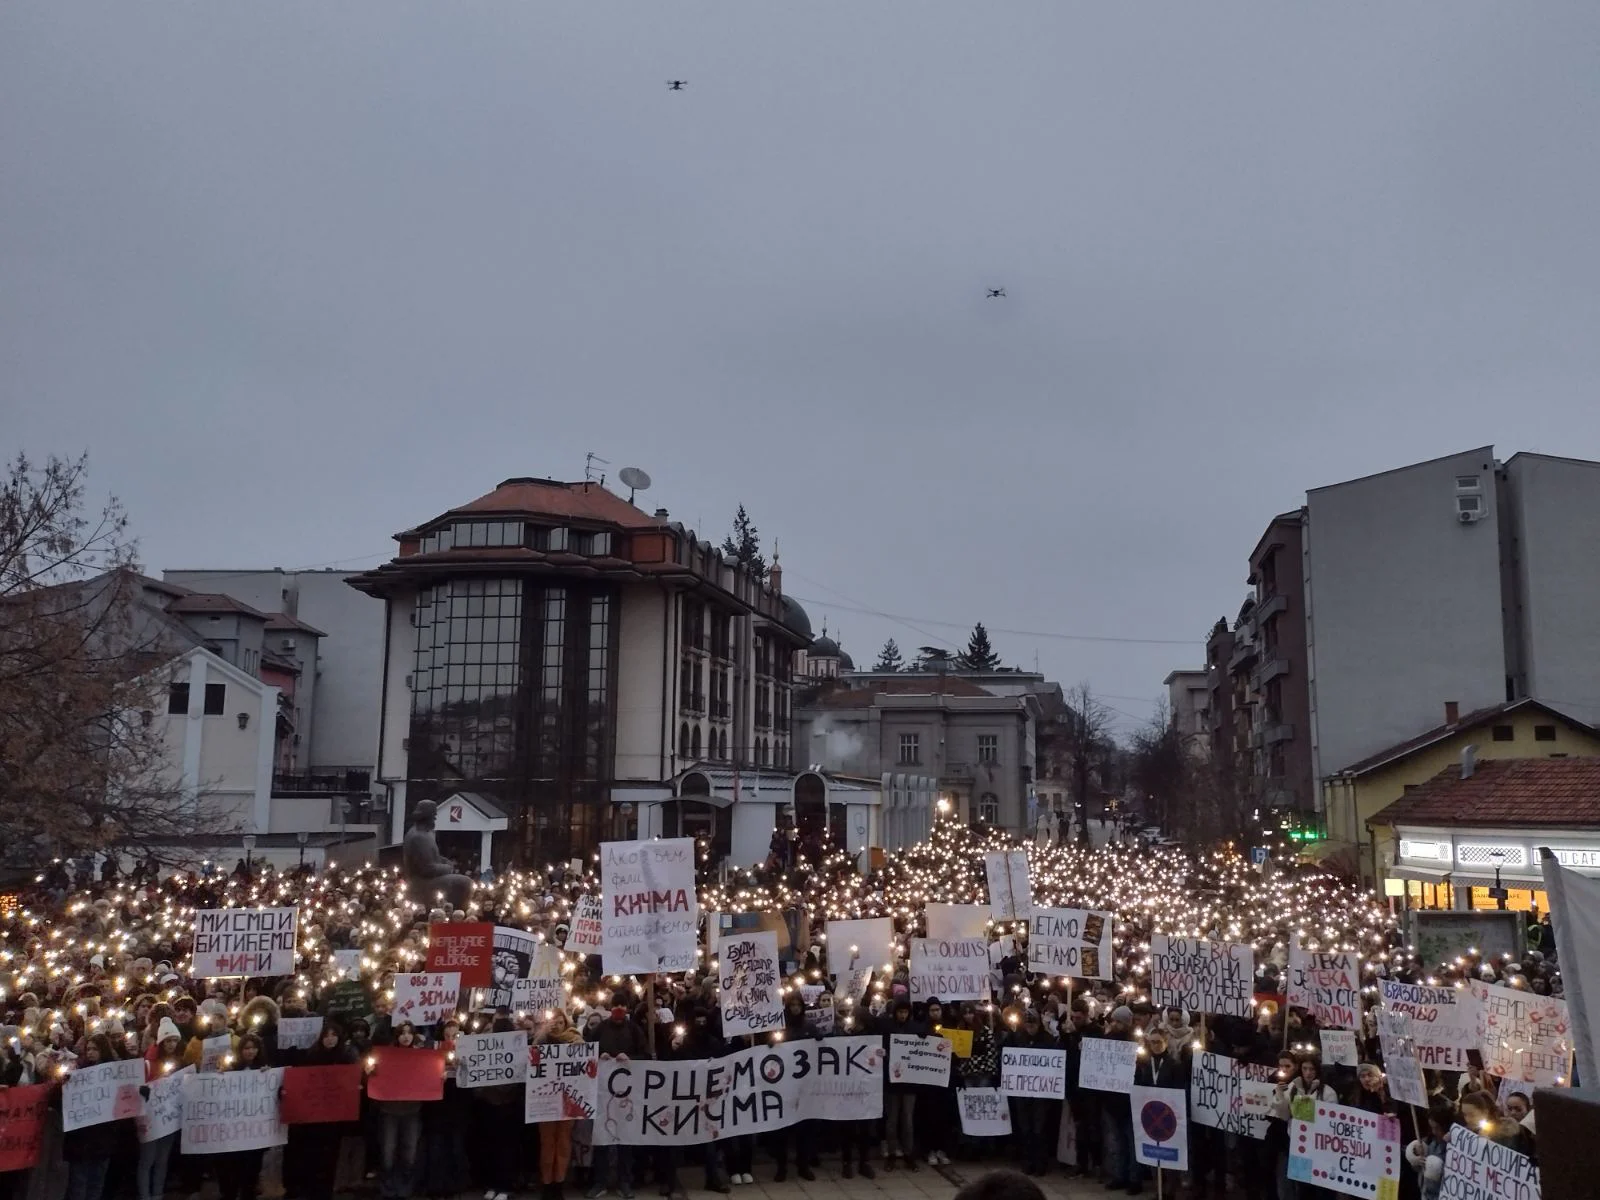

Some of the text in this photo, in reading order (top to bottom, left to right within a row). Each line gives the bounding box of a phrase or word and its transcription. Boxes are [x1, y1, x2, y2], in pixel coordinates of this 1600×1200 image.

[614, 889, 689, 917] КИЧМА
[200, 912, 293, 932] МИ СМО И
[447, 945, 467, 956] BEZ
[727, 941, 756, 962] БУДИ
[1167, 937, 1240, 961] КО ЈЕ ВАС
[434, 955, 480, 967] BLOKADE
[1153, 953, 1240, 980] ПОЗНАВАО НИ
[1152, 987, 1252, 1018] ТЕШКО ПАСТИ
[477, 1038, 505, 1052] DUM
[468, 1052, 514, 1068] SPIRO
[732, 1044, 873, 1091] МОЗАК
[1202, 1052, 1219, 1073] ОД
[468, 1067, 514, 1083] SPERO
[530, 1063, 546, 1079] ЈЕ
[1002, 1074, 1014, 1091] НЕ
[1196, 1087, 1219, 1110] ДО
[641, 1089, 783, 1136] КИЧМА
[1314, 1133, 1372, 1159] ПРОБУДИ
[1450, 1126, 1481, 1158] САМО
[1339, 1156, 1356, 1174] СЕ
